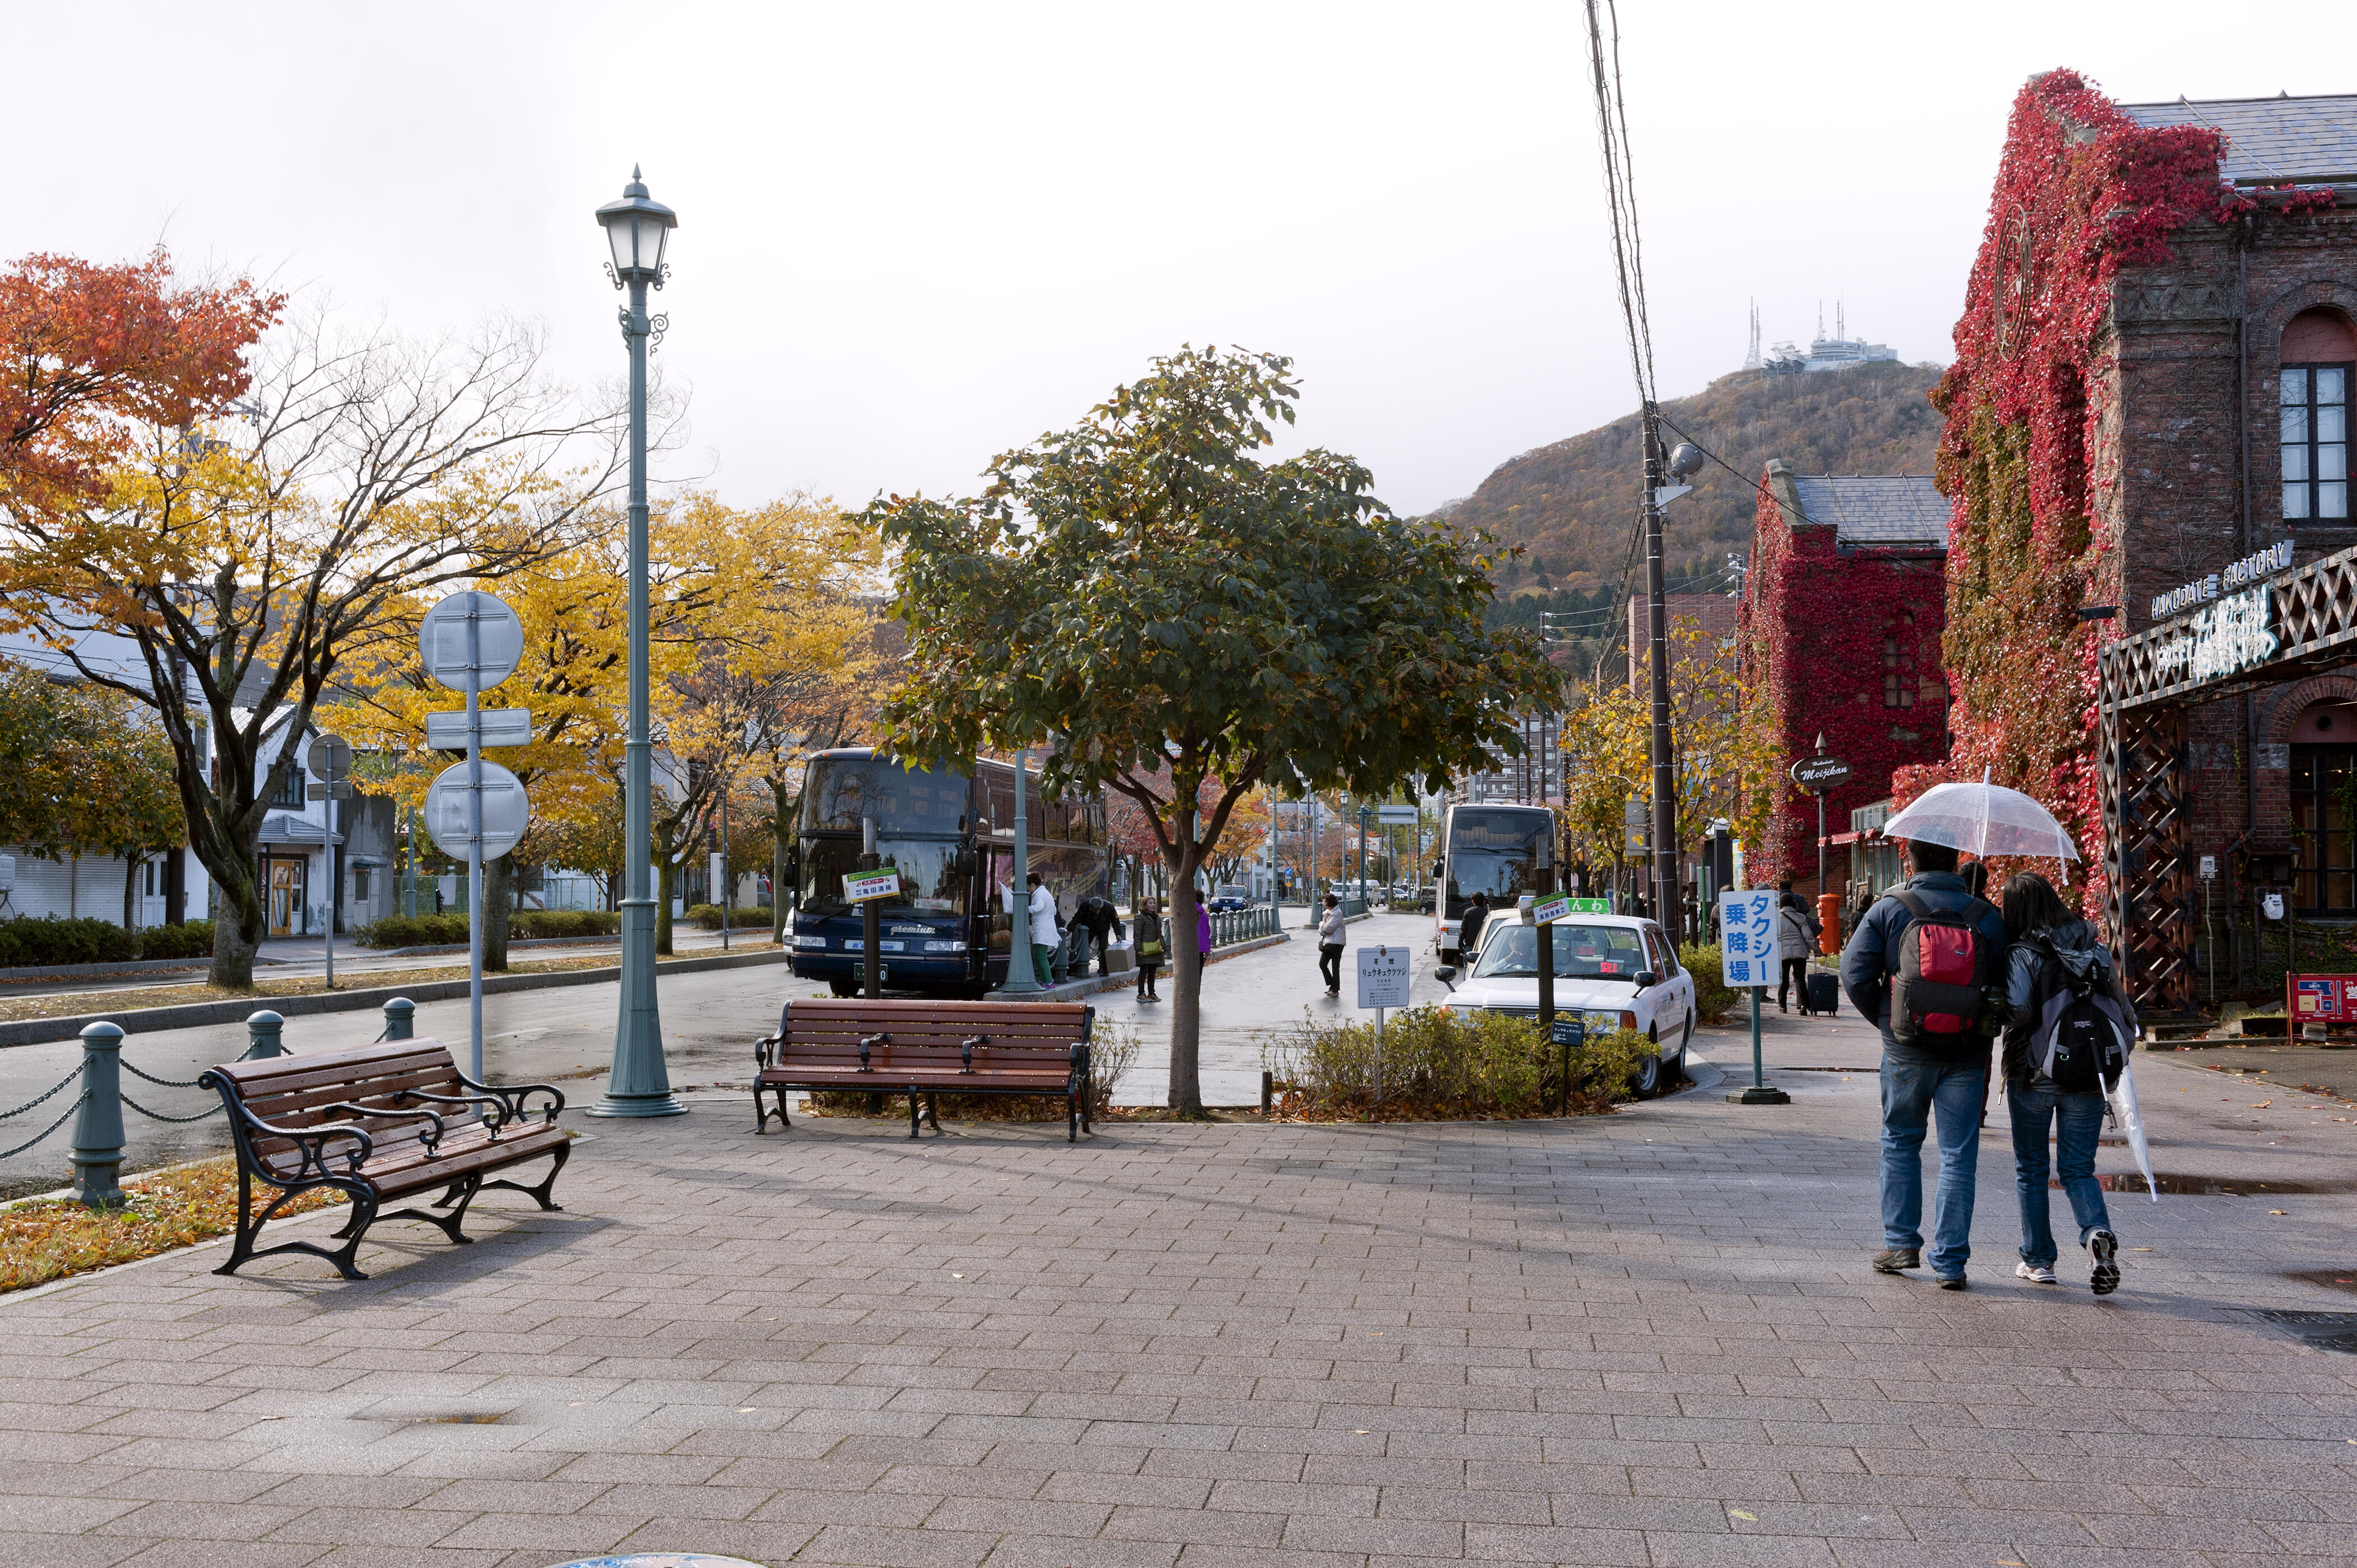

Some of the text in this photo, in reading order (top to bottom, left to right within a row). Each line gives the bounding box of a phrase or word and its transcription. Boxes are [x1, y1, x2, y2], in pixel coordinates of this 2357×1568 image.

[2151, 541, 2290, 620] HAKODATE FACTORY
[1800, 766, 1848, 781] Meijikan
[890, 924, 936, 935] premium
[1726, 903, 1750, 982] 乗降場
[1750, 895, 1772, 981] タクシー
[1363, 967, 1406, 977] リュウキュウツツジ
